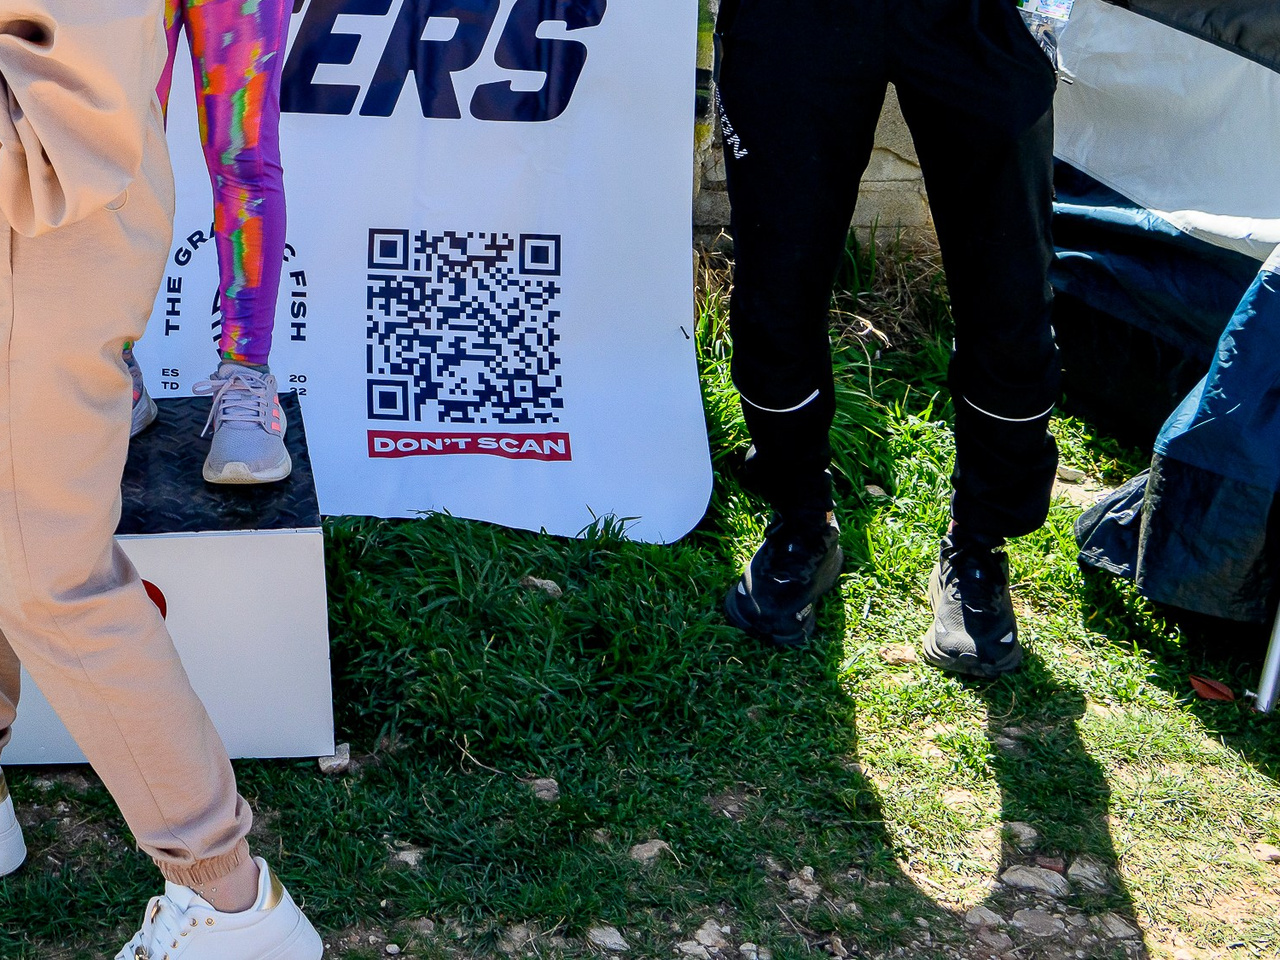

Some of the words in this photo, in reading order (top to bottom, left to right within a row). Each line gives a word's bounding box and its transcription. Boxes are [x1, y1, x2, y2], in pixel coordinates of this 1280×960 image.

[165, 276, 182, 336] THE
[289, 270, 307, 342] FISH
[161, 368, 179, 377] ES
[289, 375, 307, 383] 20
[161, 381, 179, 390] TD
[373, 437, 472, 453] DON'T
[477, 437, 566, 455] SCAN
